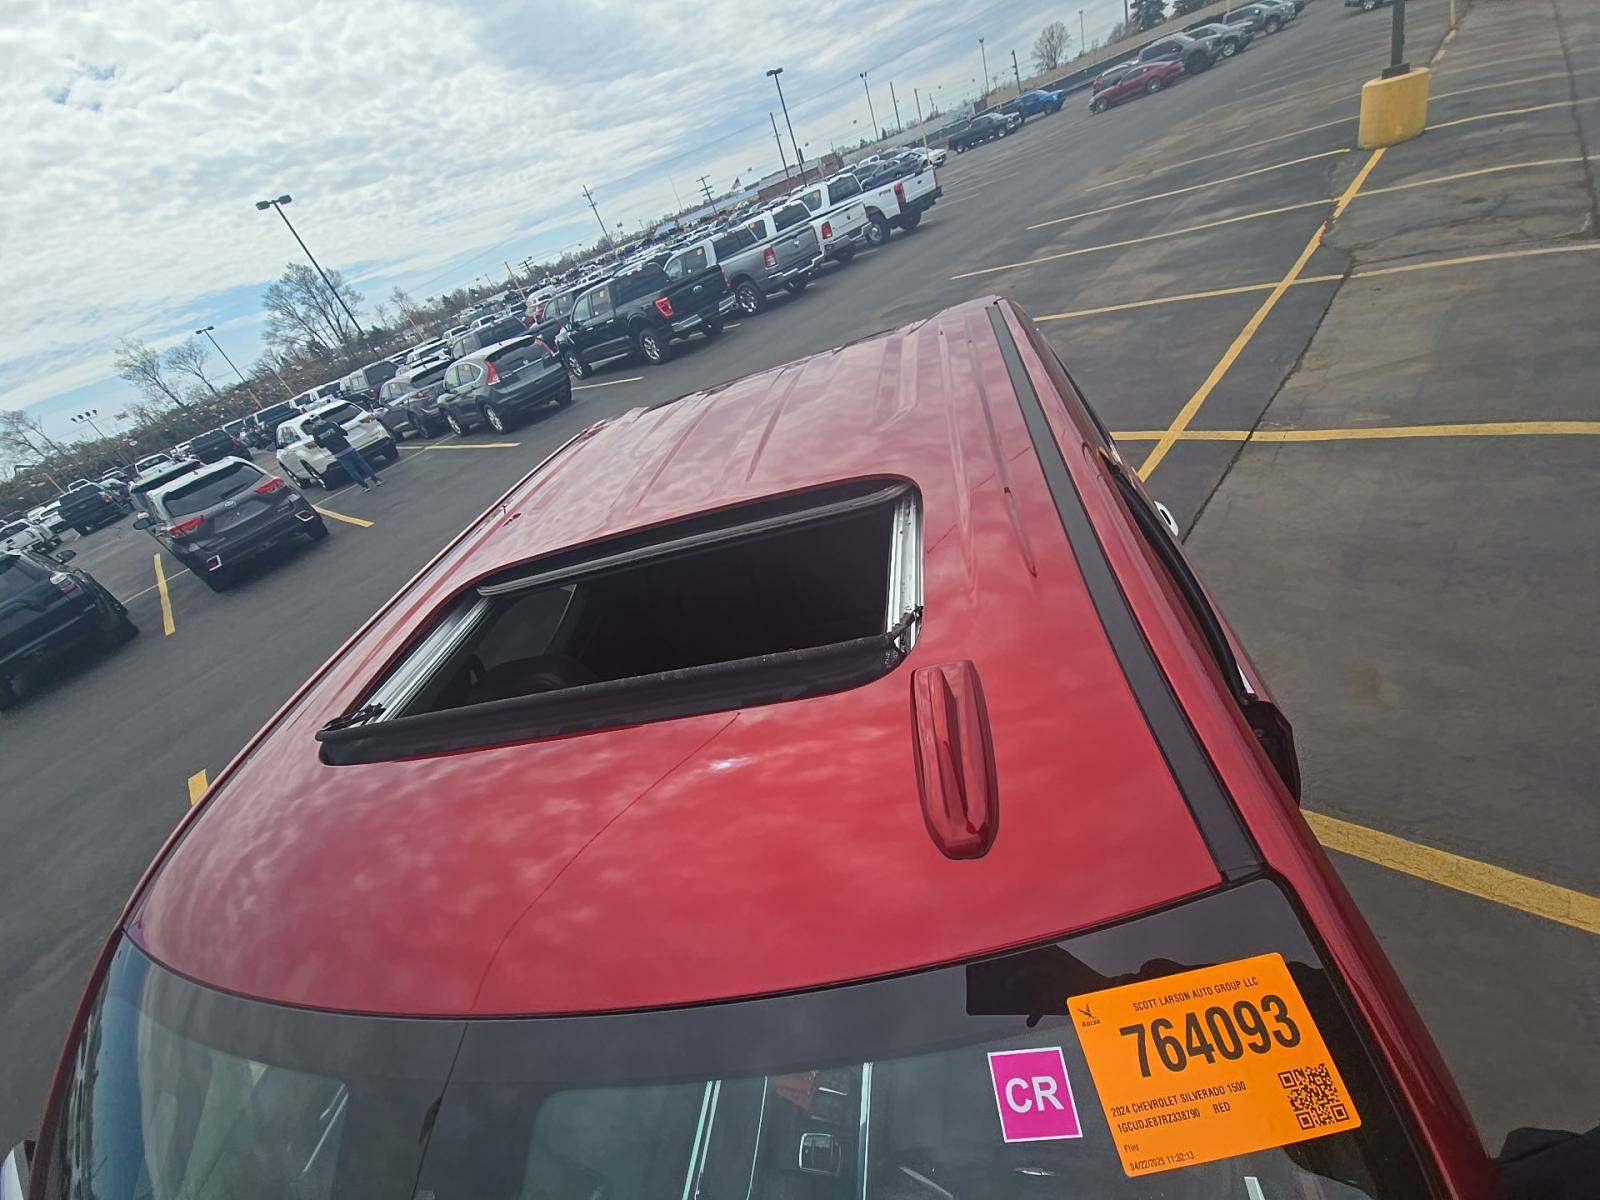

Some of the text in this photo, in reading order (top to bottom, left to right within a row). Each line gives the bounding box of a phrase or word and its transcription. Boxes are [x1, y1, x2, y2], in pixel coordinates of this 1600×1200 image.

[1133, 976, 1259, 1012] SCOTT LARSON AUTO GROUP LLC
[1119, 994, 1302, 1078] 764093
[1005, 1075, 1064, 1113] CR
[1111, 1080, 1247, 1117] 2024 CHEVROLET SILVERADO 1500
[1213, 1101, 1231, 1114] RED
[1124, 1144, 1140, 1153] Flint
[1130, 1151, 1195, 1171] 04/22/2025 11:32:13
